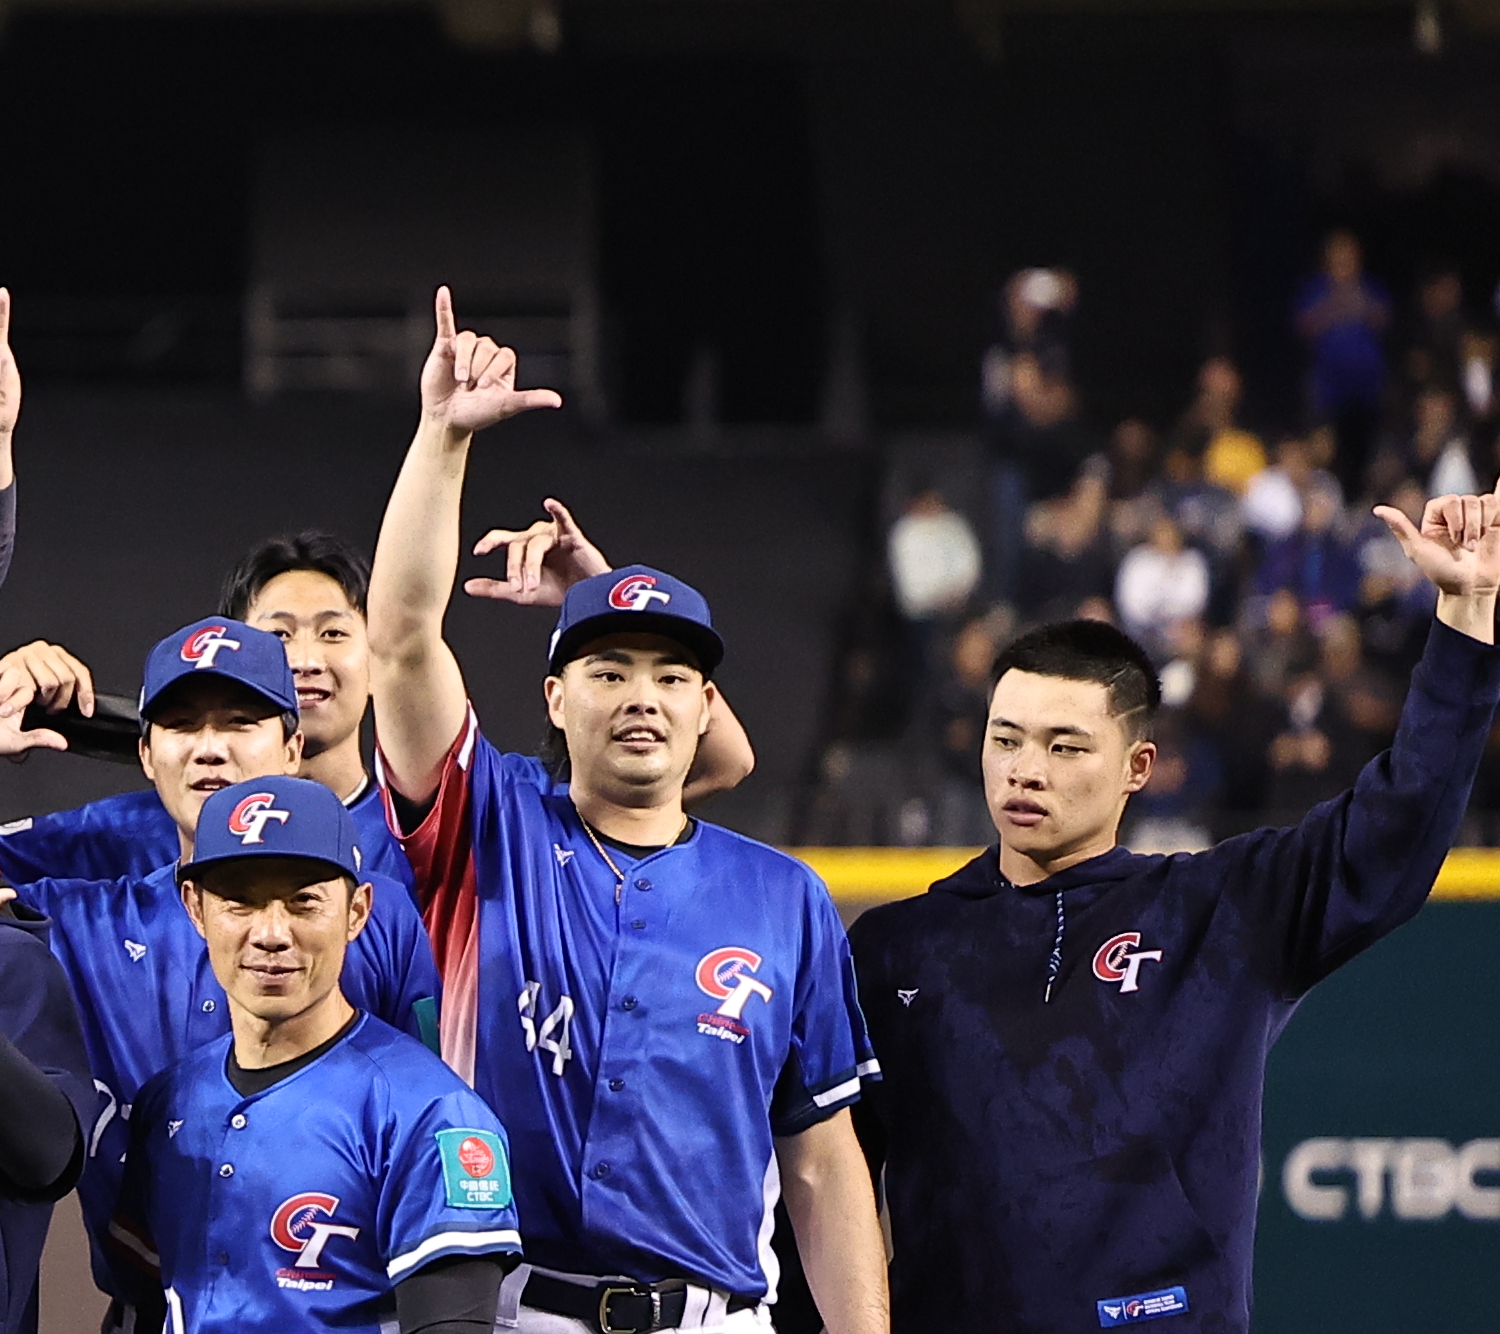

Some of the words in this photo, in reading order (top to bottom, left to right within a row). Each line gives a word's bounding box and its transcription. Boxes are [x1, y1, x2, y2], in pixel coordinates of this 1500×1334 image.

[697, 1022, 745, 1044] Taipei
[1282, 1135, 1500, 1222] CTBC
[466, 1191, 494, 1202] CTBC
[276, 1277, 334, 1292] Taipei
